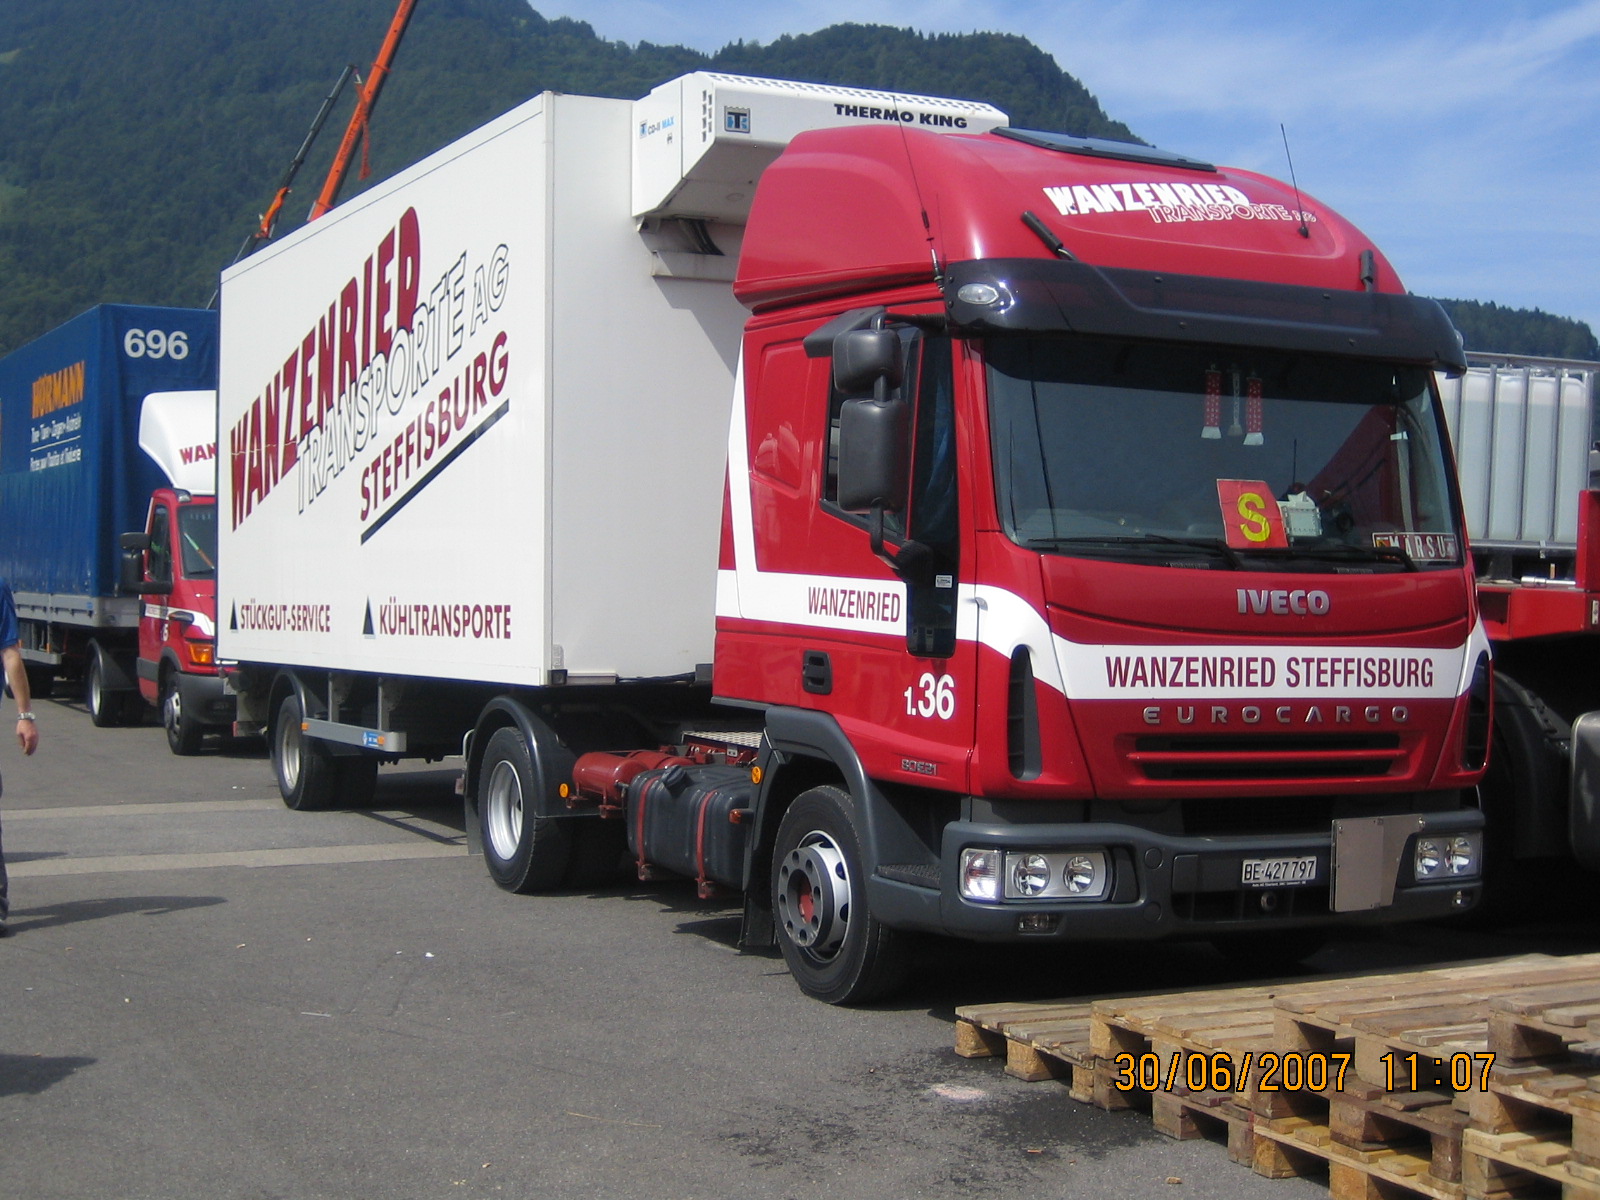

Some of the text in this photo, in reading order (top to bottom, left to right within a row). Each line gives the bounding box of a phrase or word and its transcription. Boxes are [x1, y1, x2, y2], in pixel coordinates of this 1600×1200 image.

[834, 103, 967, 128] THERMO KING
[1043, 183, 1250, 216] WANZENRIED
[1146, 204, 1293, 224] TRANSPORTE
[124, 328, 189, 360] 696
[229, 206, 420, 534] WANZENRIED
[297, 243, 510, 516] TRANSPORTE AG
[361, 331, 509, 522] STEFFISBURG
[1237, 493, 1272, 542] S
[240, 598, 331, 633] STÜCKGUT-SERVICE
[379, 596, 511, 640] KÜHLTRANSPORTE
[808, 586, 901, 623] WANZENRIED
[1236, 588, 1330, 616] IVECO
[1105, 656, 1434, 688] WANZENRIED STEFFISBURG
[904, 672, 955, 720] 1.36
[1143, 705, 1409, 725] EUROCARGO
